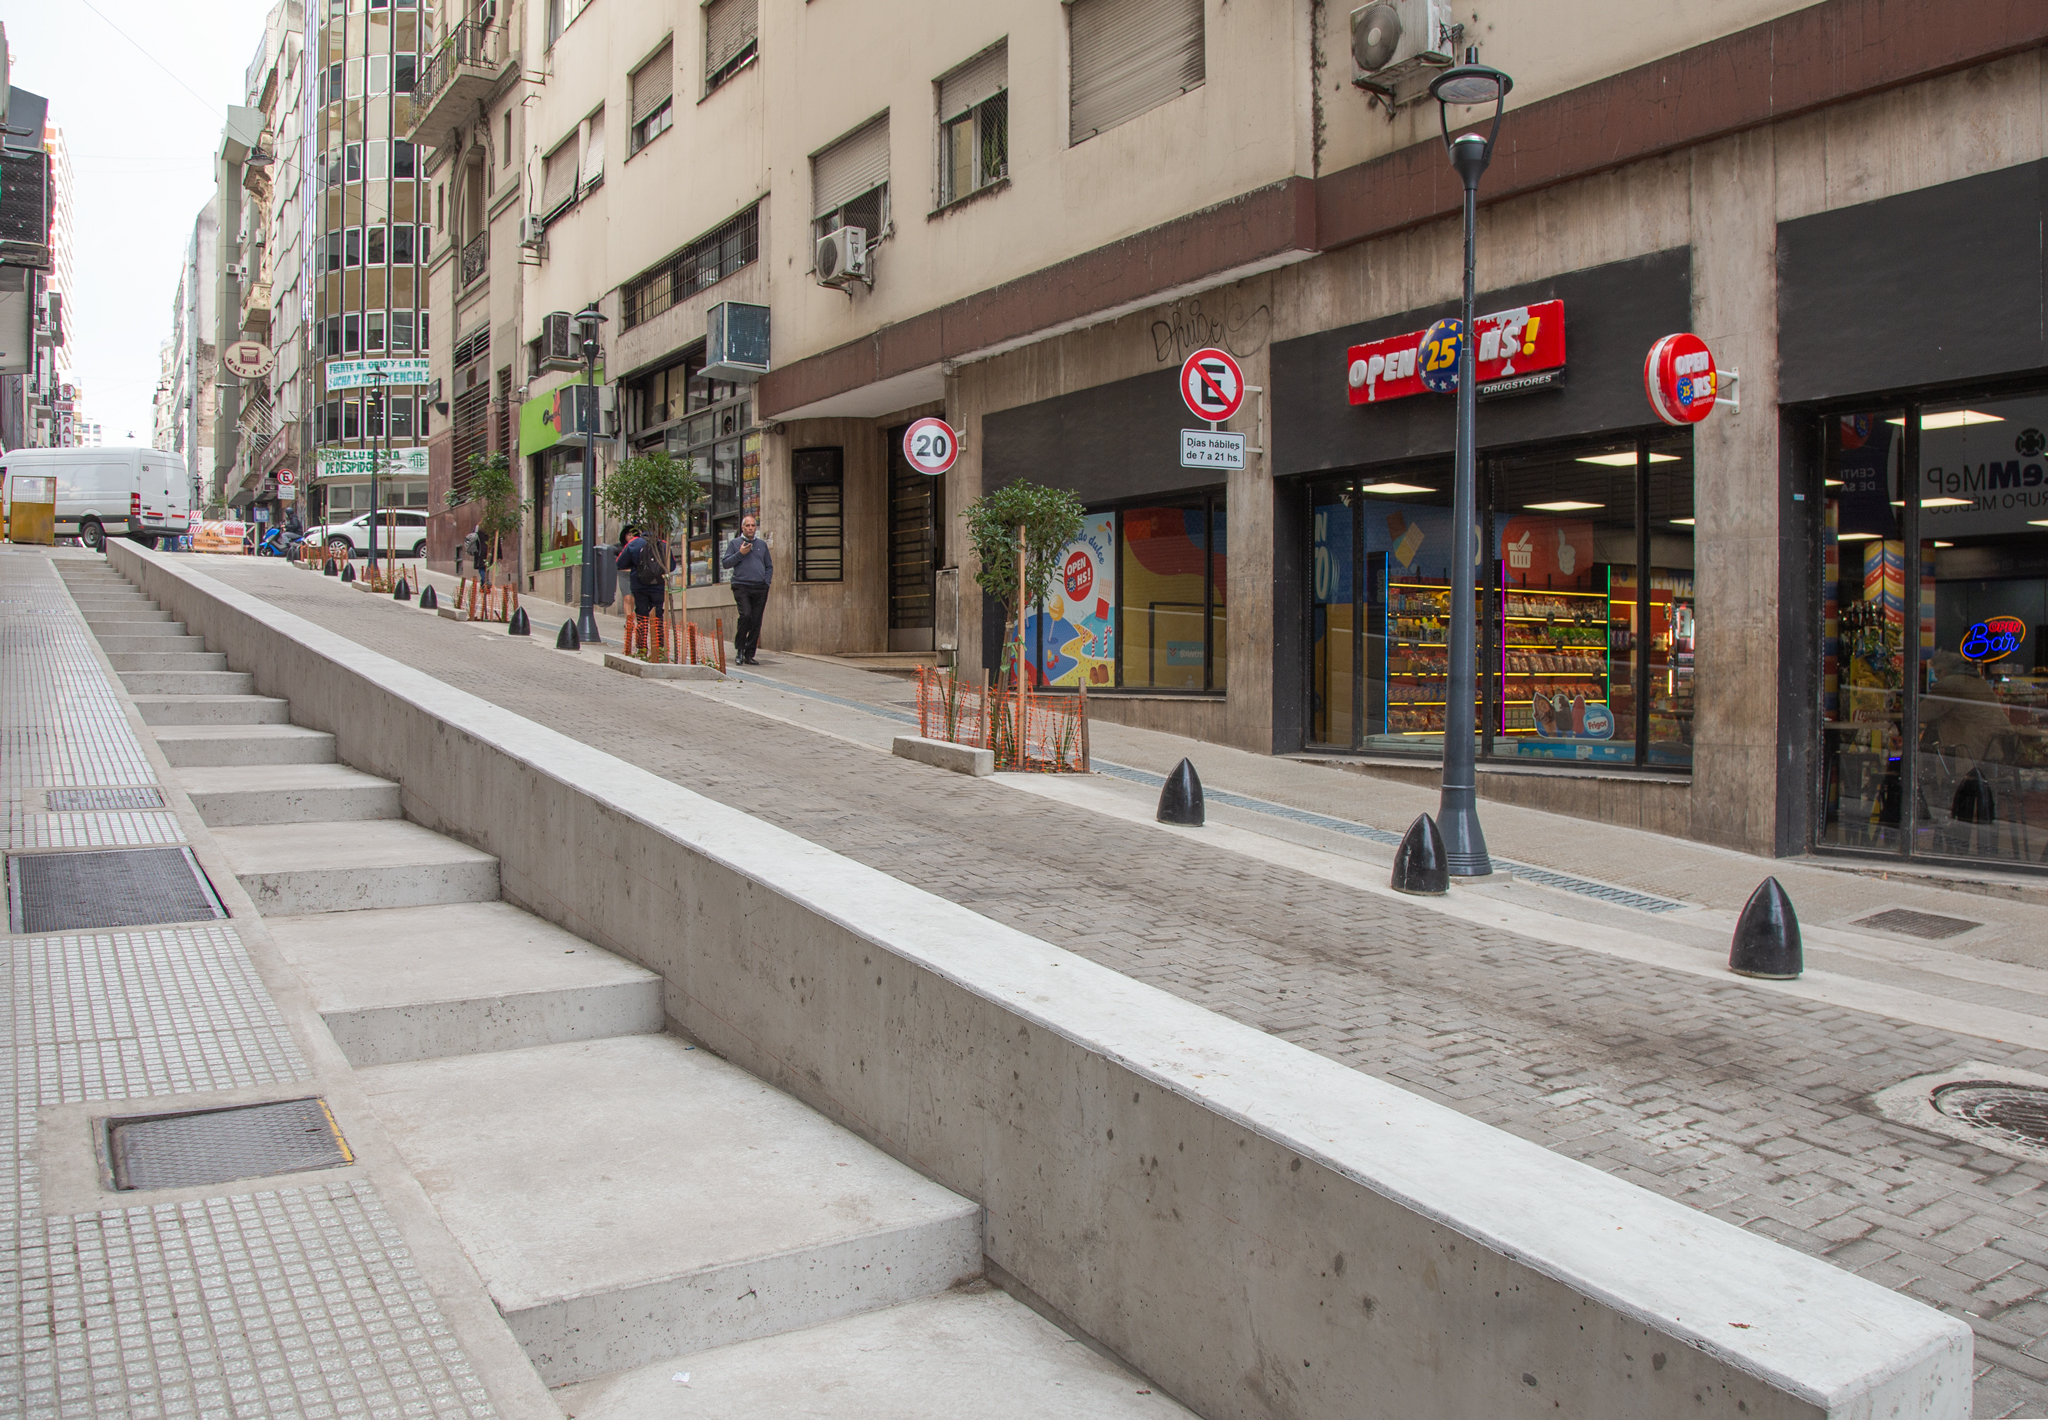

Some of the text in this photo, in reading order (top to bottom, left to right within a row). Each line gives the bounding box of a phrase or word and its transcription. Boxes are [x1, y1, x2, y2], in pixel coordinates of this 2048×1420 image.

[1348, 316, 1541, 388] OPEN 25 HS!
[329, 363, 354, 375] FRENTE
[356, 362, 366, 371] AL
[1675, 351, 1709, 376] OPEN
[353, 374, 360, 385] Y
[361, 371, 423, 384] RESTENCIA
[1482, 375, 1552, 394] DRUGSTORES
[1693, 371, 1716, 398] HS!
[916, 434, 946, 457] 20
[1187, 437, 1240, 450] Días hábiles
[1186, 451, 1197, 459] de
[1200, 451, 1205, 459] 7
[1215, 452, 1224, 461] 21
[1227, 453, 1240, 462] hs.
[326, 462, 334, 474] DE
[1088, 536, 1105, 564] dulce
[1067, 556, 1087, 576] OPEN
[1077, 567, 1091, 586] HS!
[1989, 620, 2021, 633] OPEN
[1963, 622, 2020, 658] Bar
[1587, 720, 1607, 730] Frigor
